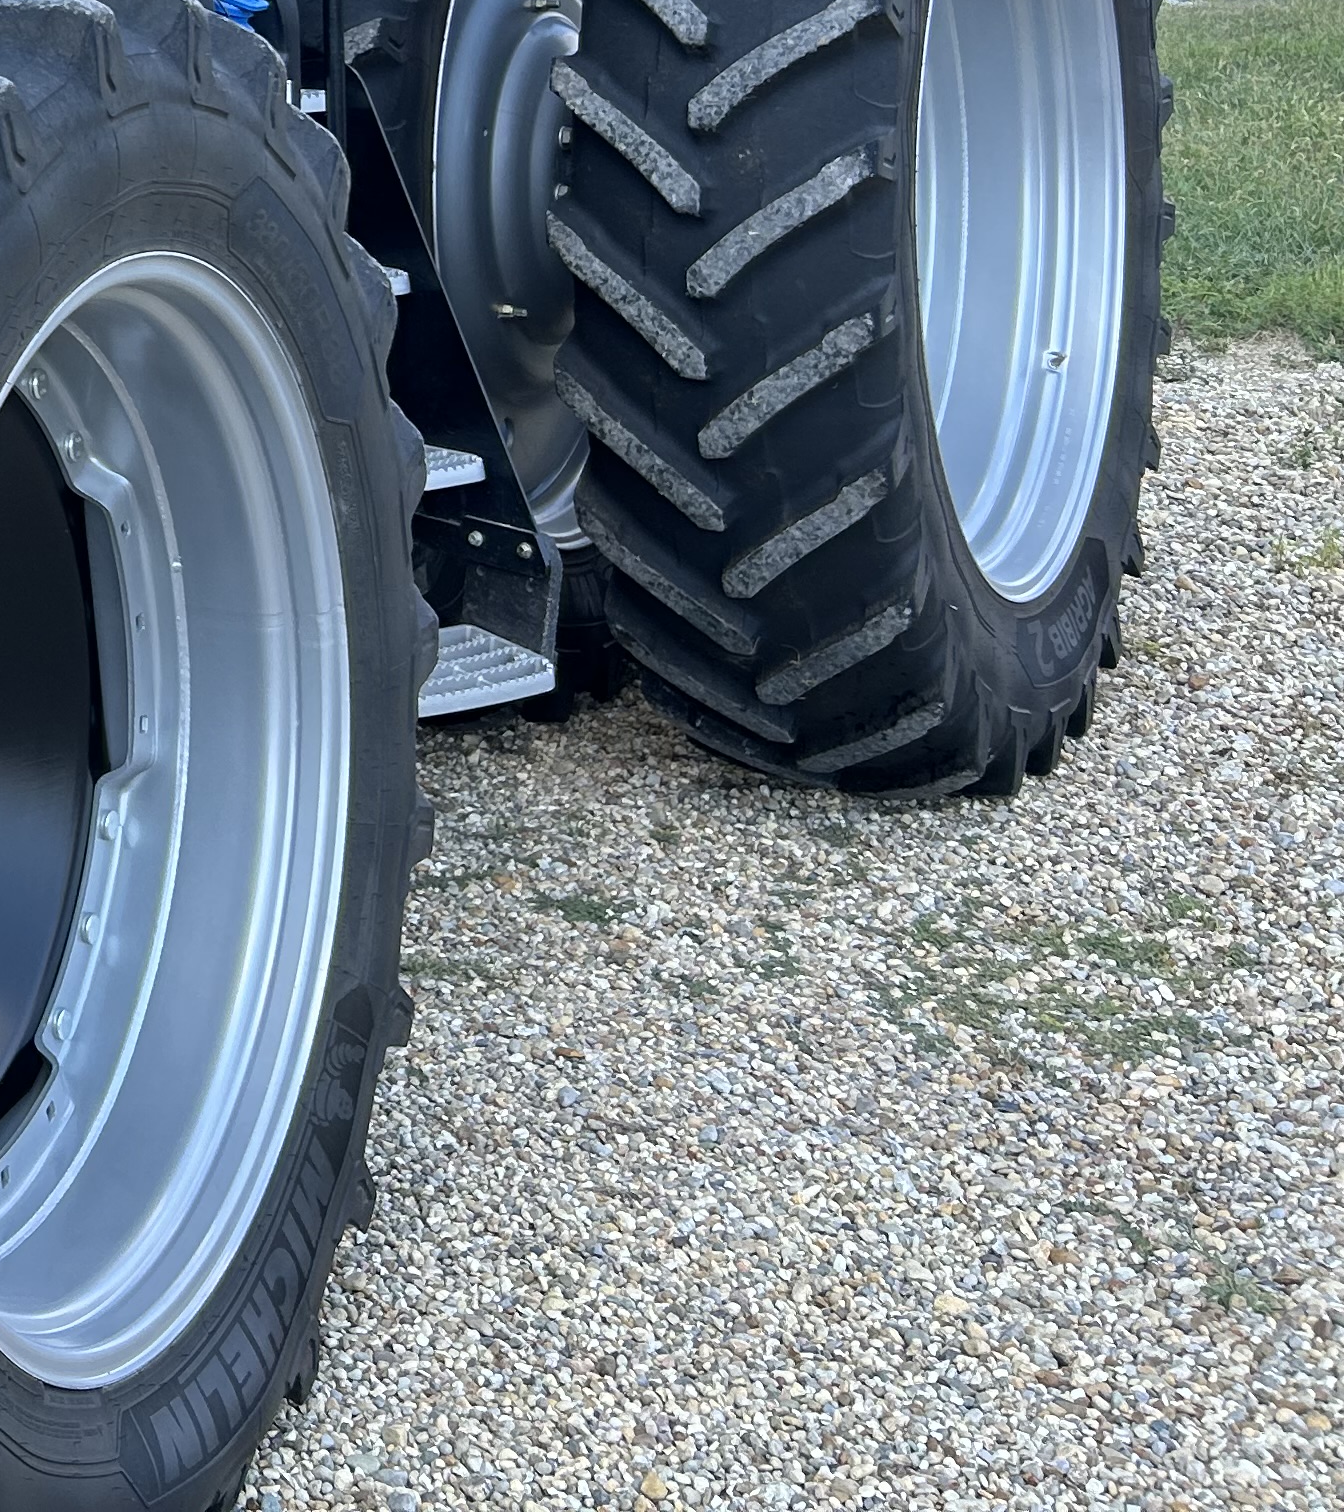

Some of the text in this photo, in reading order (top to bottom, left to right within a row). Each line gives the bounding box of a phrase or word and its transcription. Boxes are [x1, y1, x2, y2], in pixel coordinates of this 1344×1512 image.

[1025, 618, 1056, 678] 2
[1046, 565, 1096, 660] AGRIBIB
[148, 1136, 343, 1484] MICHELIN
